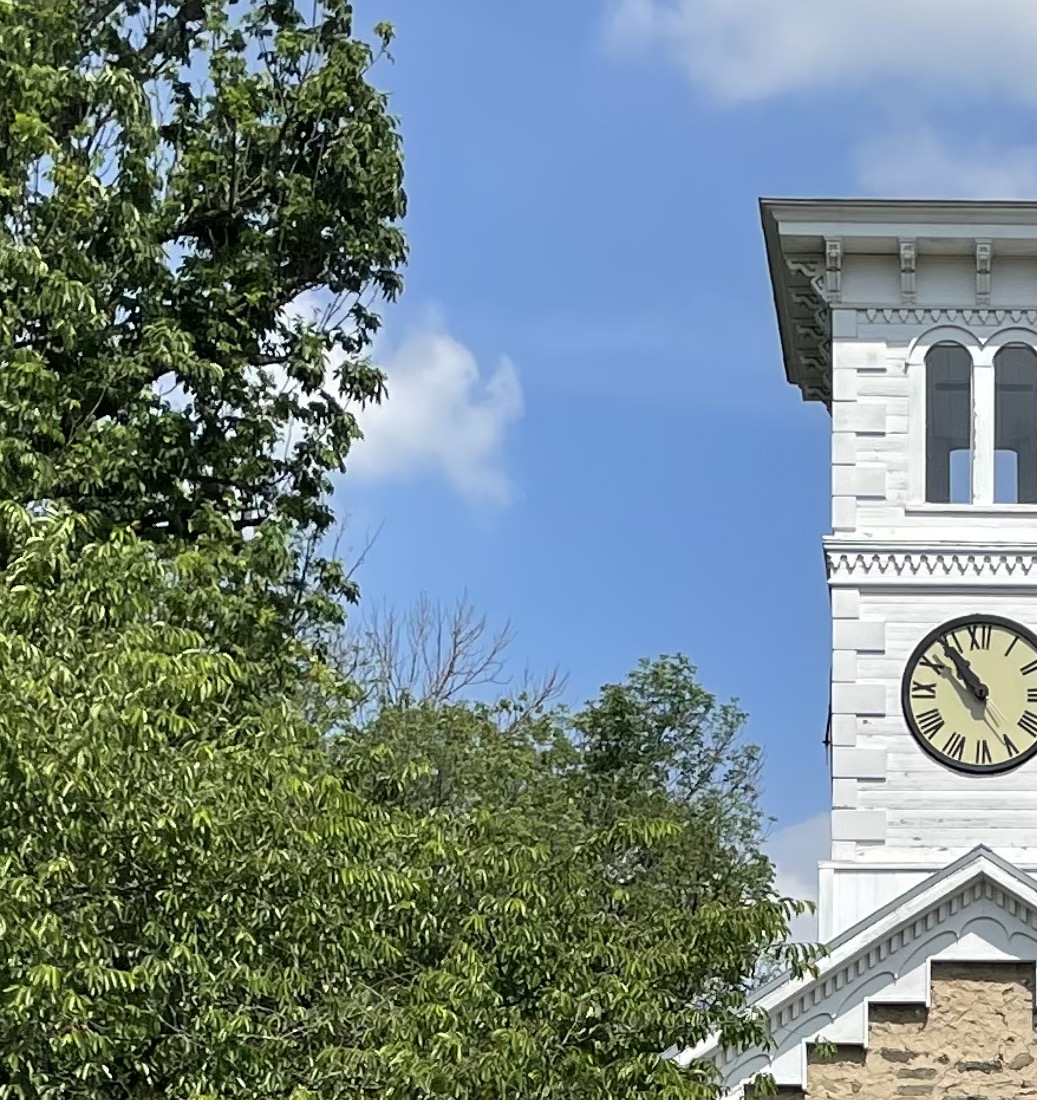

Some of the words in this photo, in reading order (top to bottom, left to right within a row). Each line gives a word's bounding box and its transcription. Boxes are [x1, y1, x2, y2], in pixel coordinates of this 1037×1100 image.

[967, 625, 992, 651] XII
[911, 681, 937, 699] IX
[942, 732, 966, 761] VII
[976, 740, 992, 764] VI
[1003, 733, 1020, 757] V
